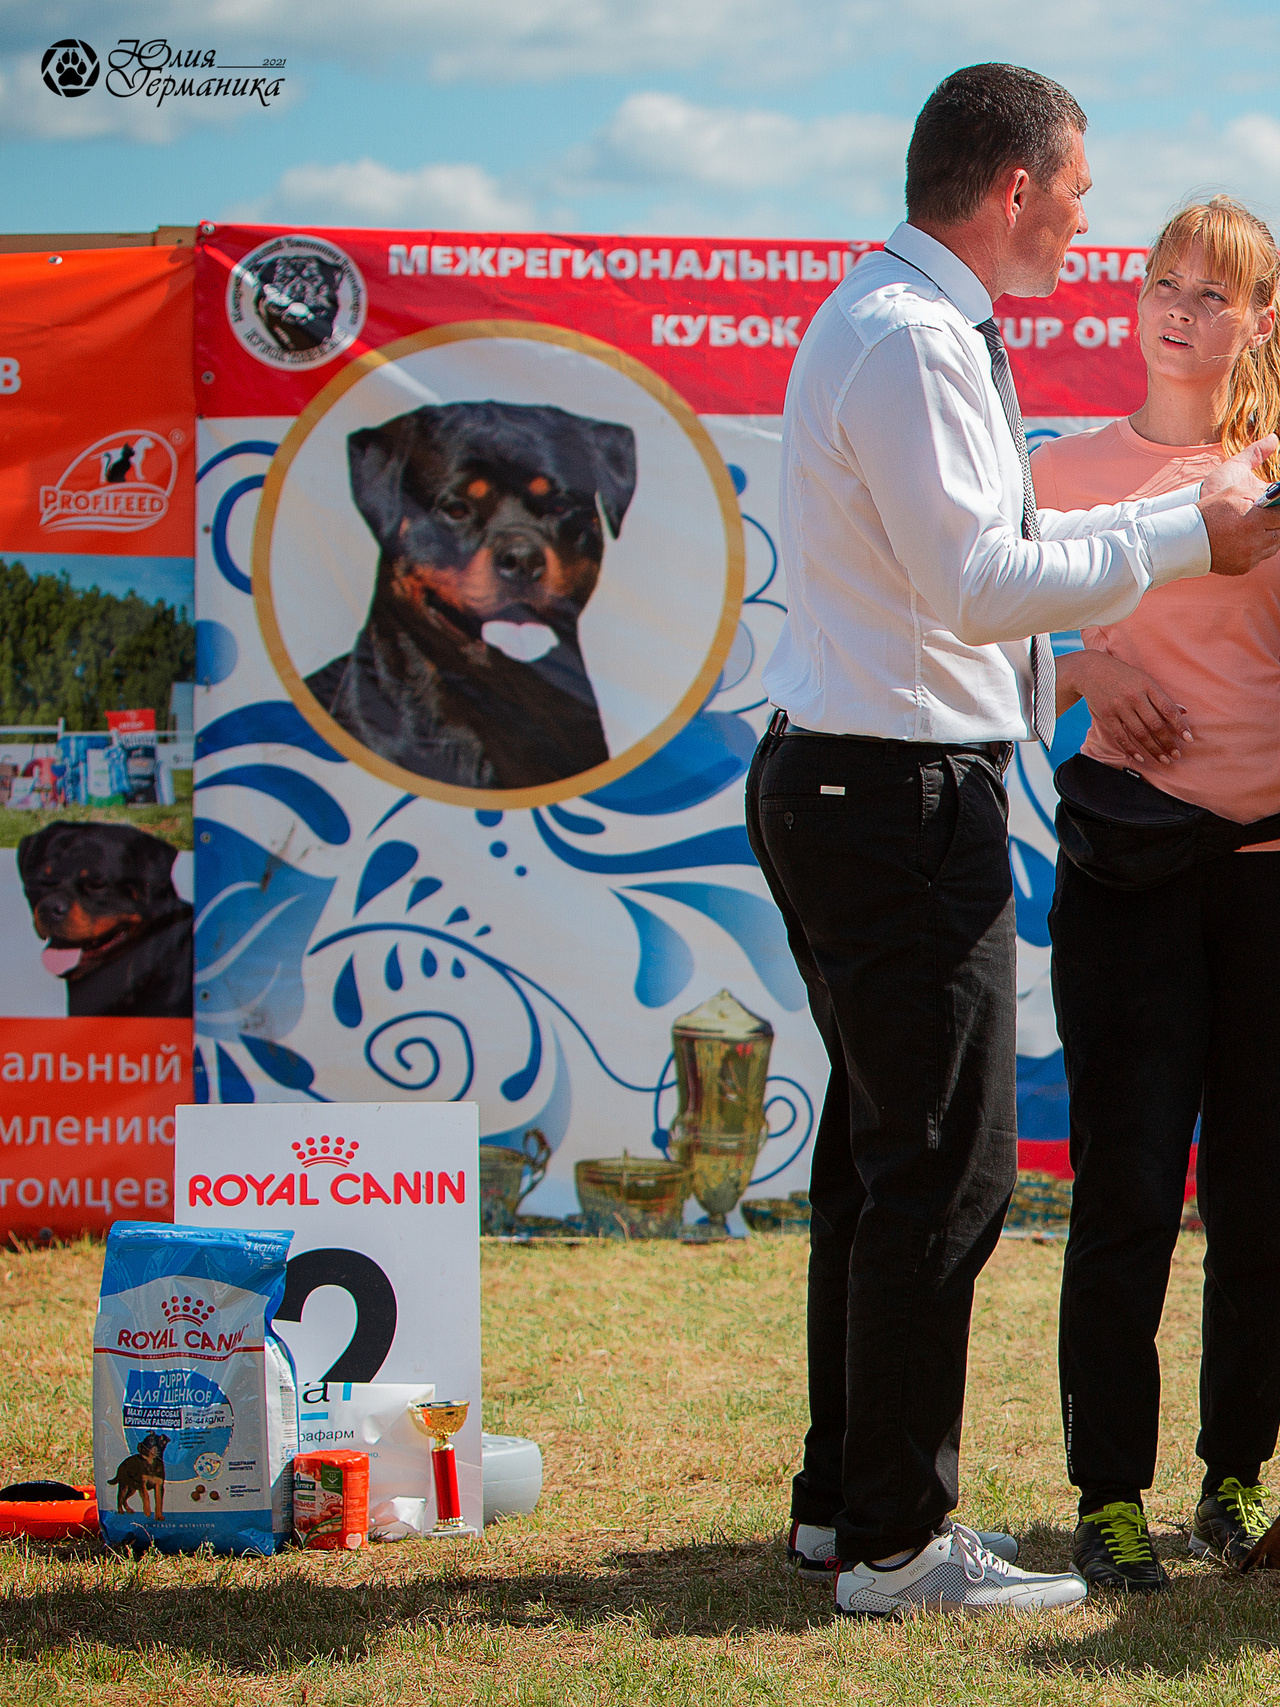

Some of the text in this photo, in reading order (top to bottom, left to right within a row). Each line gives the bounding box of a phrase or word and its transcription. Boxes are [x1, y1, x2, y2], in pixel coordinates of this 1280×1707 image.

[651, 315, 801, 348] КУБОК
[994, 315, 1131, 350] UP OF
[41, 485, 168, 514] PROFIFEED
[1, 1043, 182, 1084] альный
[188, 1170, 466, 1207] ROYAL CANIN
[117, 1328, 178, 1350] ROYAL
[158, 1372, 192, 1389] PUPPY
[131, 1389, 212, 1404] ДЛЯ ЩЕНКОВ
[124, 1416, 180, 1427] КРУПНЫХ РАЗМЕРОВ
[126, 1408, 143, 1416] MAXI
[160, 1409, 180, 1418] СОБАК
